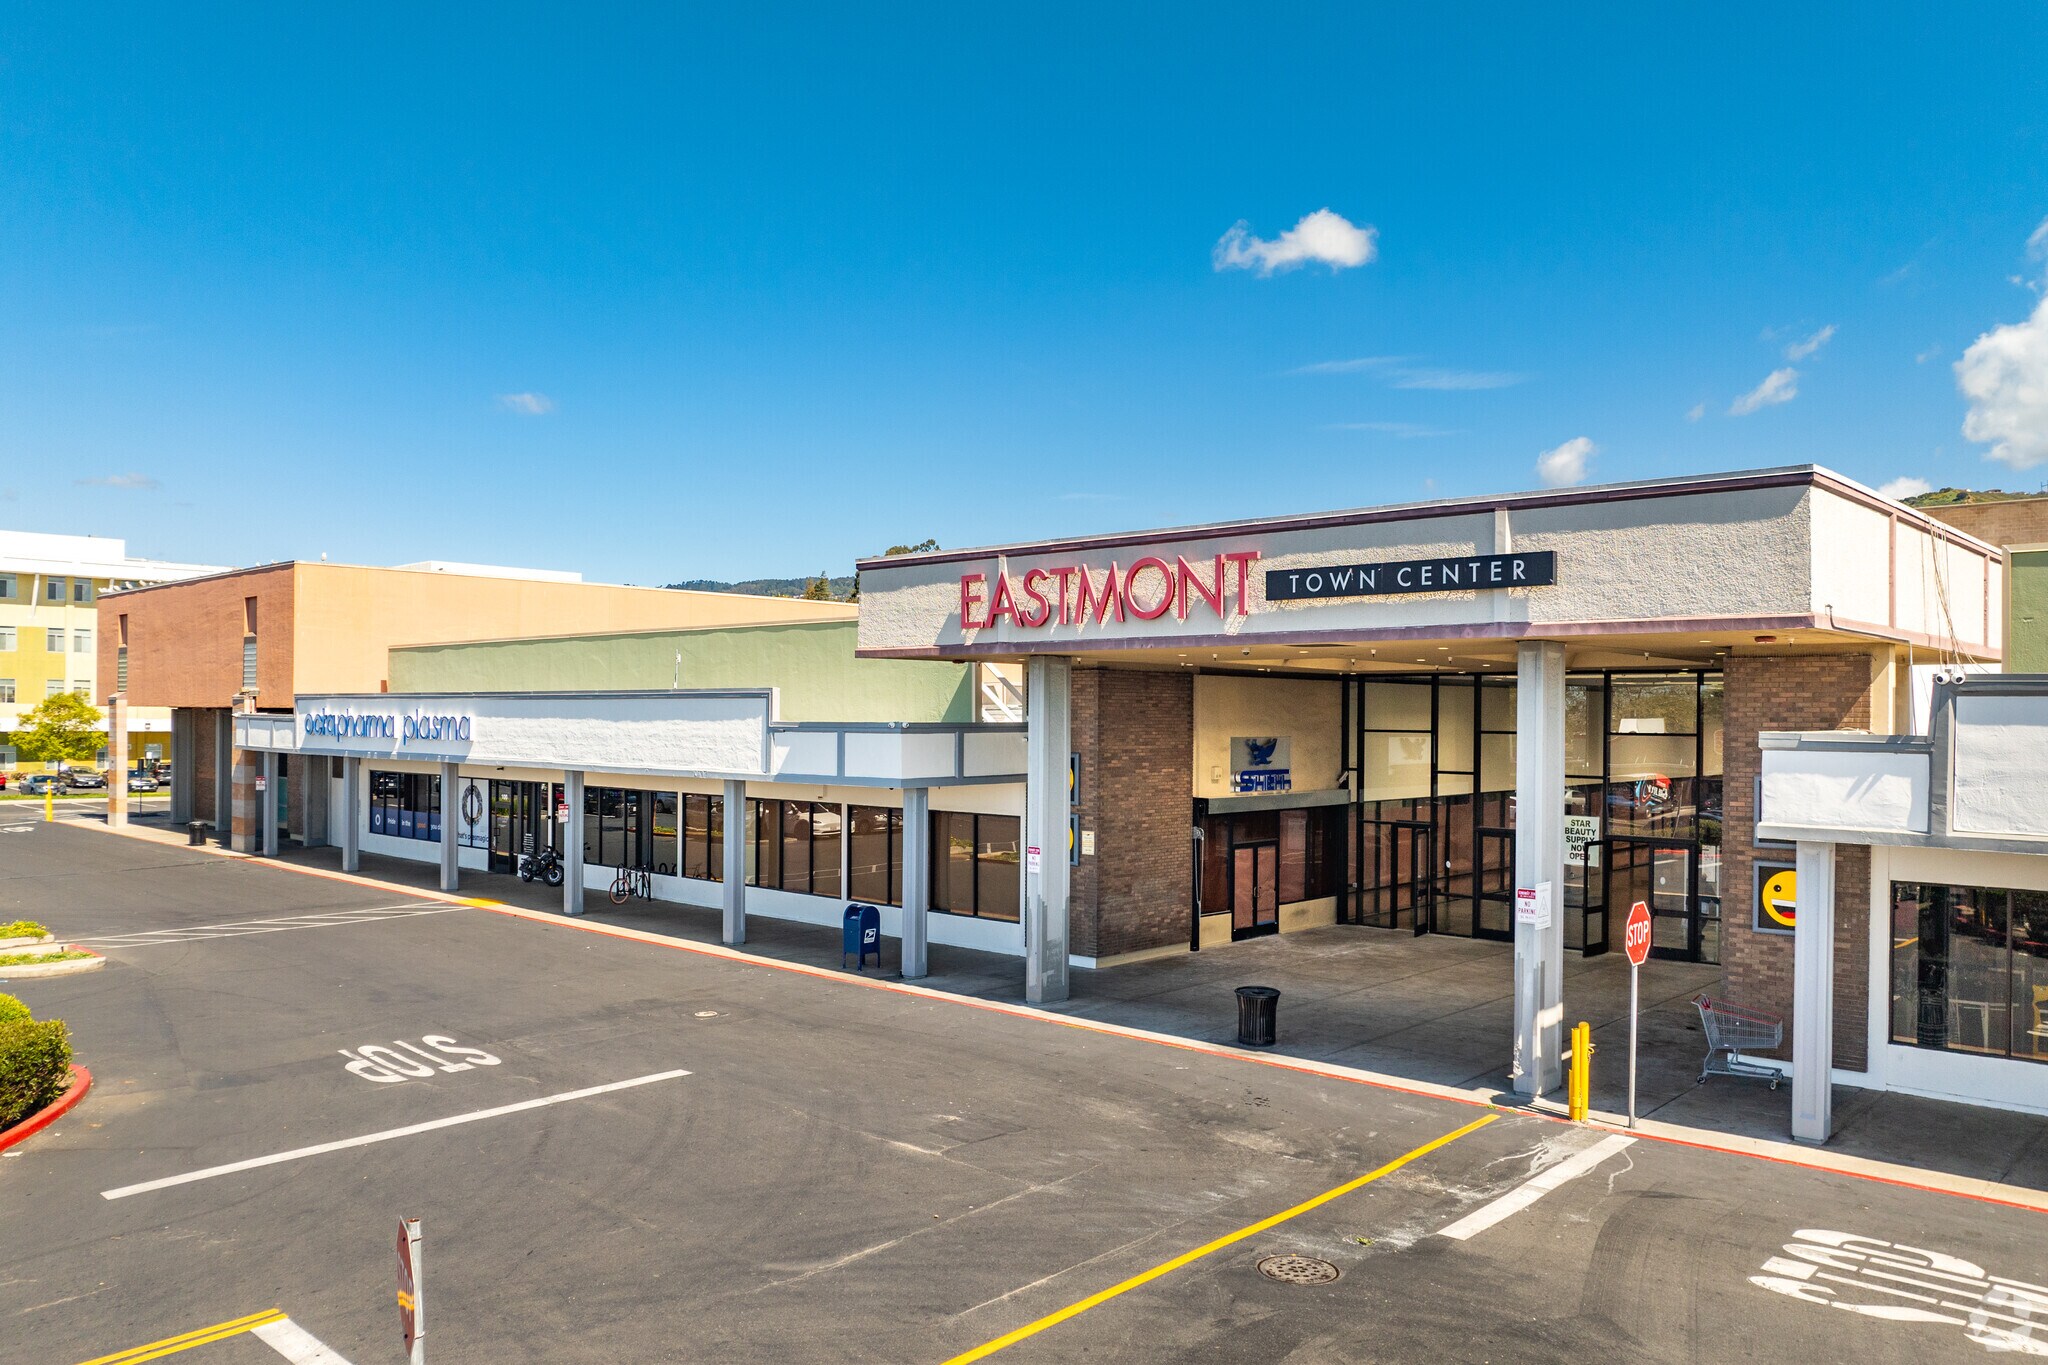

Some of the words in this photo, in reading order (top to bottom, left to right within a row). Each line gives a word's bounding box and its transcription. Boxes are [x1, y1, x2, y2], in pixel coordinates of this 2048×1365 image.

[960, 551, 1261, 629] EASTMONT
[1289, 570, 1377, 594] TOWN
[1397, 561, 1526, 587] CENTER
[305, 708, 394, 742] octapharma
[403, 709, 470, 745] plasma
[1565, 827, 1596, 836] BEAUTY
[1628, 921, 1649, 947] STOP
[337, 1035, 501, 1082] STOP
